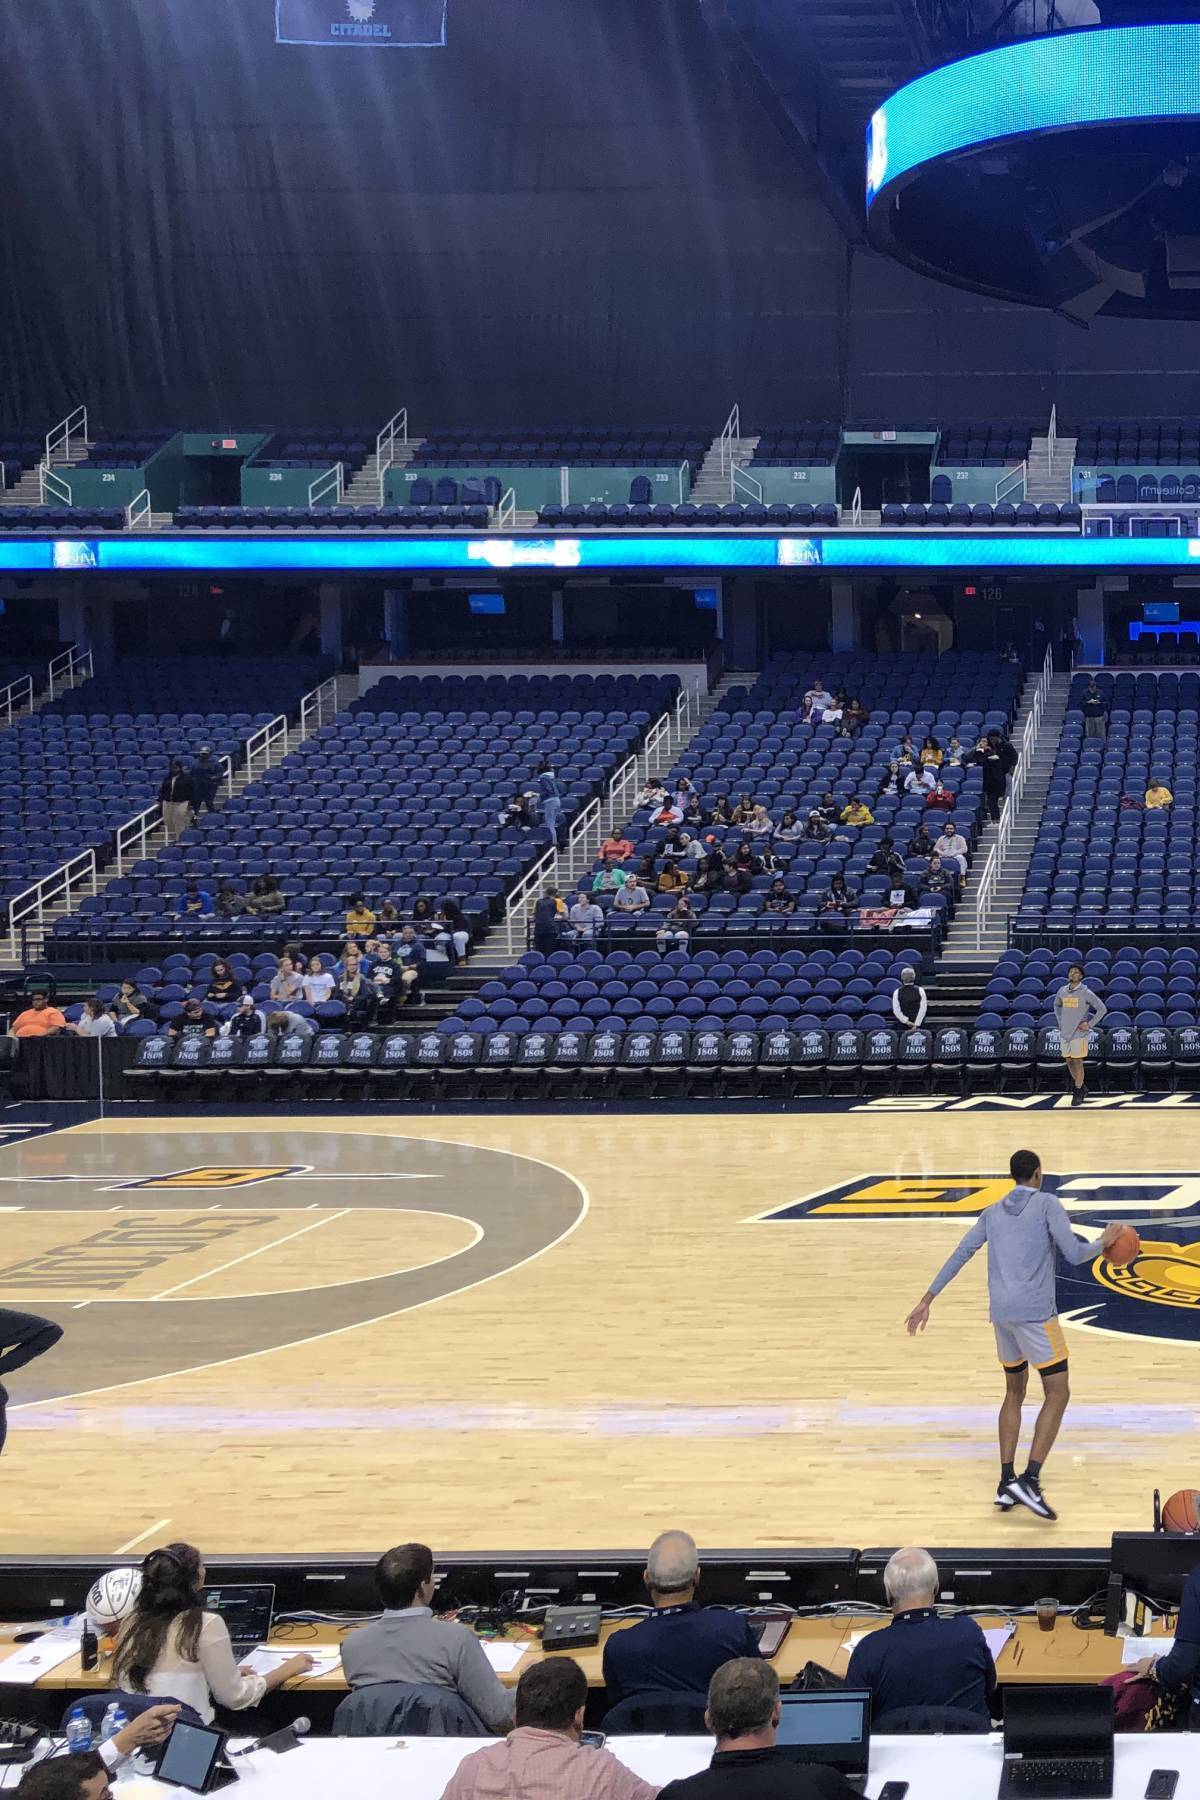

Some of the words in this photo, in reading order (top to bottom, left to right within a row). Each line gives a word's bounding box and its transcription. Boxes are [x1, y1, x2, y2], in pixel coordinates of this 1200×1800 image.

[330, 24, 392, 36] CITADEL
[793, 472, 806, 480] 232
[956, 472, 969, 480] 232
[802, 1046, 822, 1054] 1808
[837, 1046, 857, 1054] 1808
[872, 1046, 892, 1054] 1808
[906, 1046, 926, 1054] 1808
[941, 1045, 961, 1053] 1808
[1112, 1043, 1132, 1051] 1808
[1147, 1043, 1167, 1051] 1808
[1180, 1042, 1200, 1051] 1808
[143, 1051, 163, 1059] 1808
[178, 1051, 198, 1060] 1808
[211, 1050, 232, 1058] 1808
[248, 1050, 268, 1058] 1808
[282, 1050, 302, 1058] 1808
[317, 1050, 338, 1058] 1808
[350, 1050, 370, 1058] 1808
[385, 1050, 406, 1058] 1808
[418, 1050, 439, 1058] 1808
[558, 1048, 578, 1056] 1808
[630, 1050, 650, 1058] 1808
[662, 1048, 682, 1056] 1808
[698, 1048, 718, 1056] 1808
[731, 1048, 752, 1056] 1808
[769, 1048, 790, 1056] 1808
